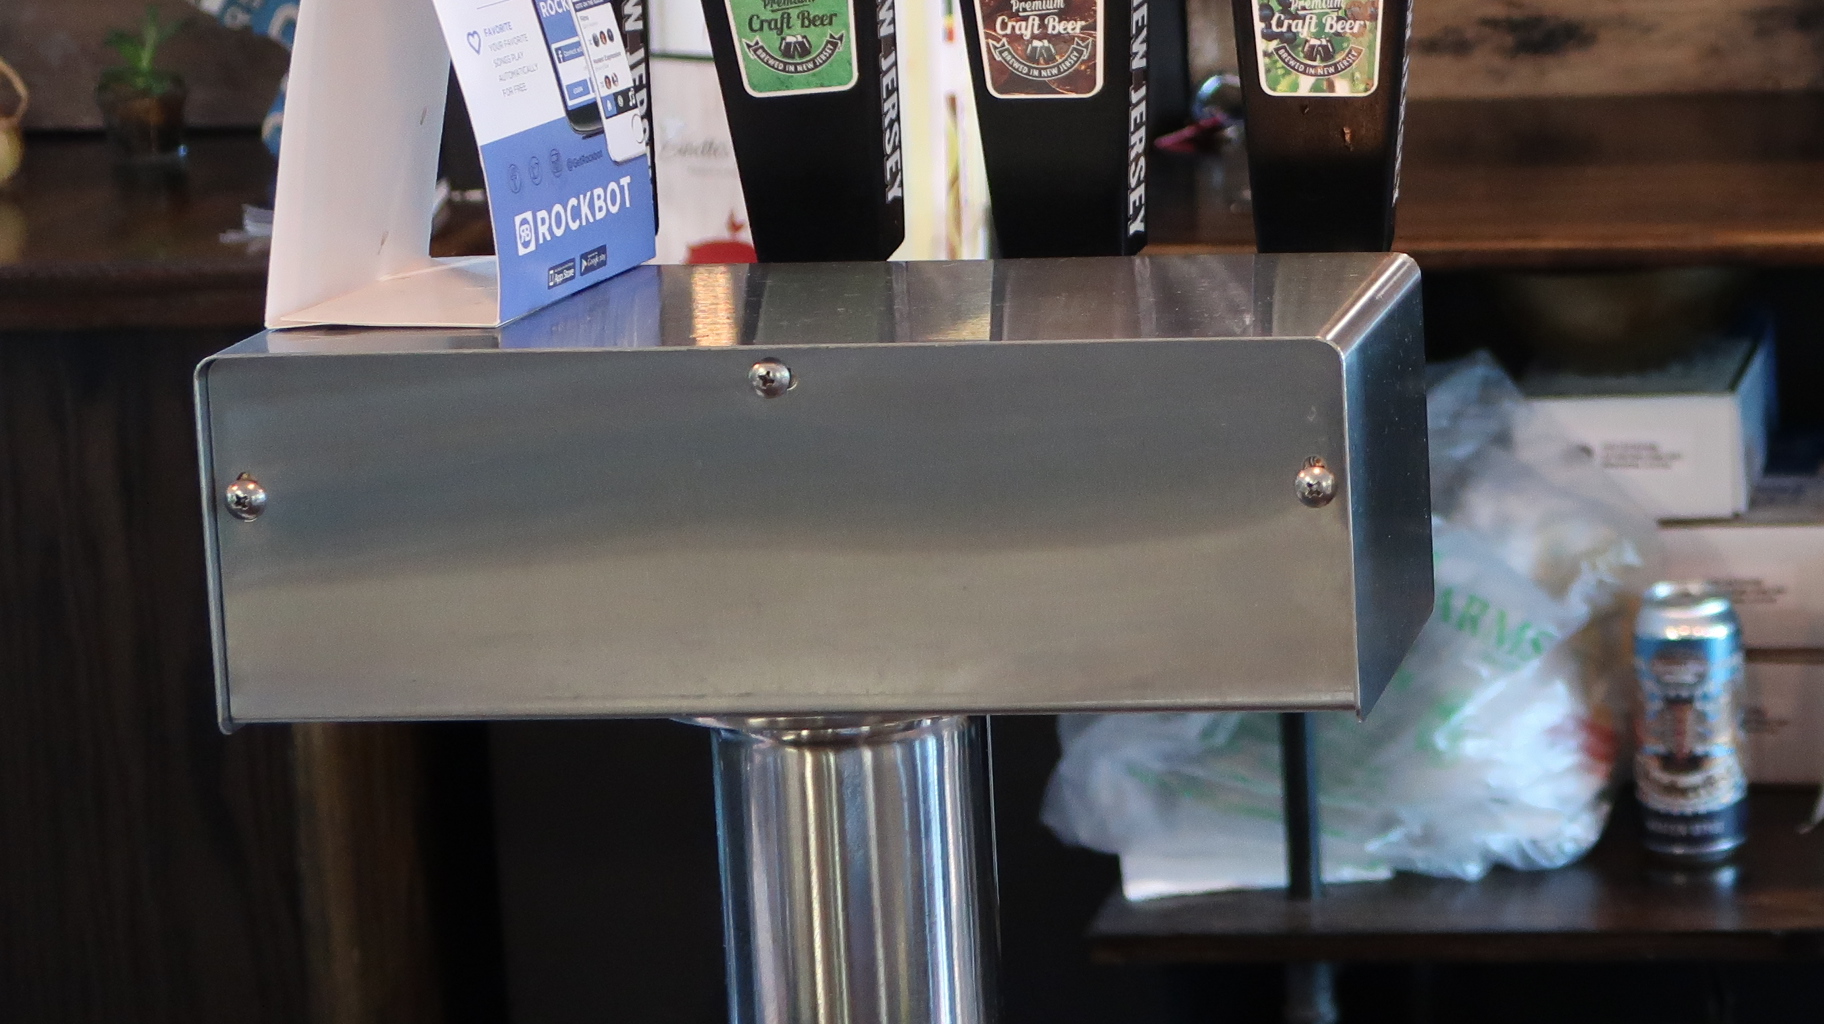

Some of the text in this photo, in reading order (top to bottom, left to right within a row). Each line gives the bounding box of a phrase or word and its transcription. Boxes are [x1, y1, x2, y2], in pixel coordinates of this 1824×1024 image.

[748, 10, 837, 36] Craft Beer
[995, 16, 1085, 40] Craft Beer
[1271, 14, 1365, 37] Craft Beer
[879, 49, 903, 204] JERSEY
[1128, 81, 1147, 238] JERSEY
[536, 176, 631, 244] ROCKBOT
